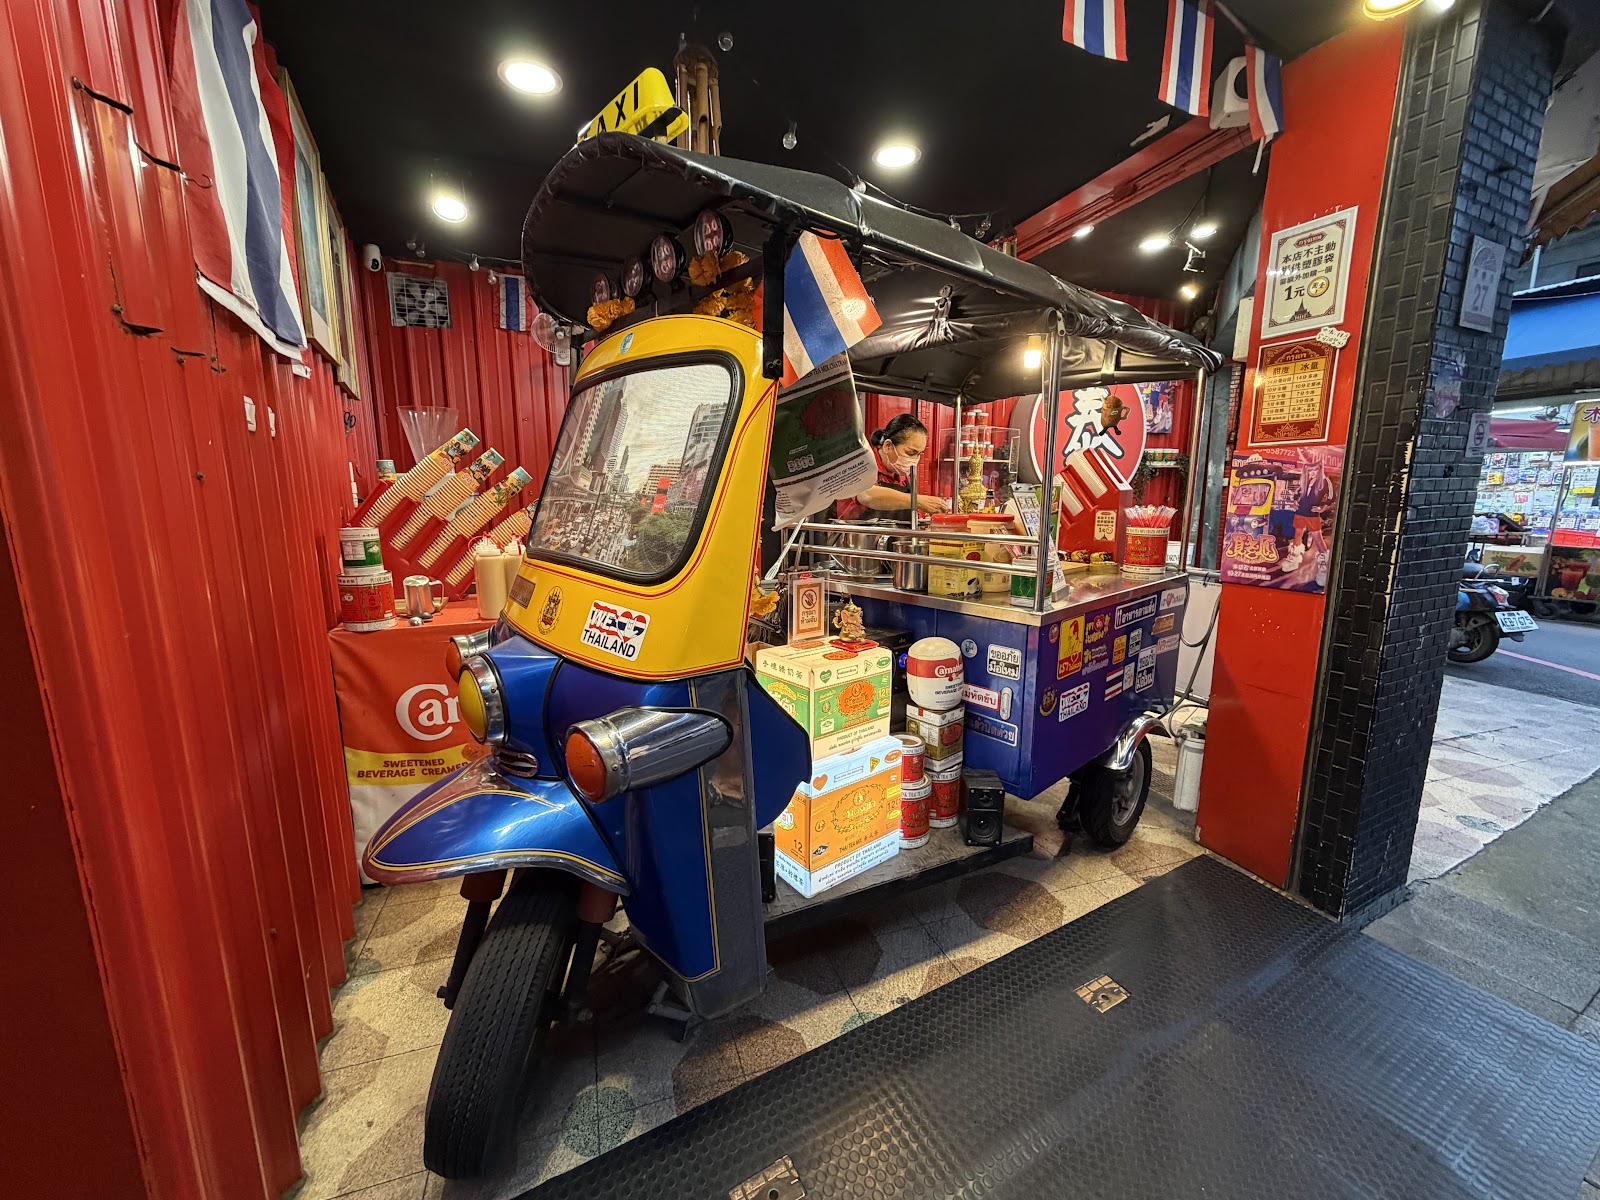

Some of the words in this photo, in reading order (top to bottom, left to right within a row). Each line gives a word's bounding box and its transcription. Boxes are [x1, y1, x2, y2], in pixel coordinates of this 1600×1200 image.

[1281, 240, 1337, 265] 本店不主動
[1284, 285, 1306, 302] 1元
[1472, 283, 1489, 312] 27
[582, 628, 636, 658] THAILAND
[990, 649, 1019, 664] ขออภัย
[989, 660, 1019, 678] มือใหม่
[961, 688, 997, 706] ม่หัดขับ
[395, 683, 461, 741] Car
[1060, 701, 1087, 720] THAILAND
[383, 758, 445, 768] SWEETENED
[357, 767, 416, 778] BEVERAGE
[793, 839, 803, 853] 12
[834, 855, 856, 869] PRODUCT
[862, 842, 882, 856] THAILAND
